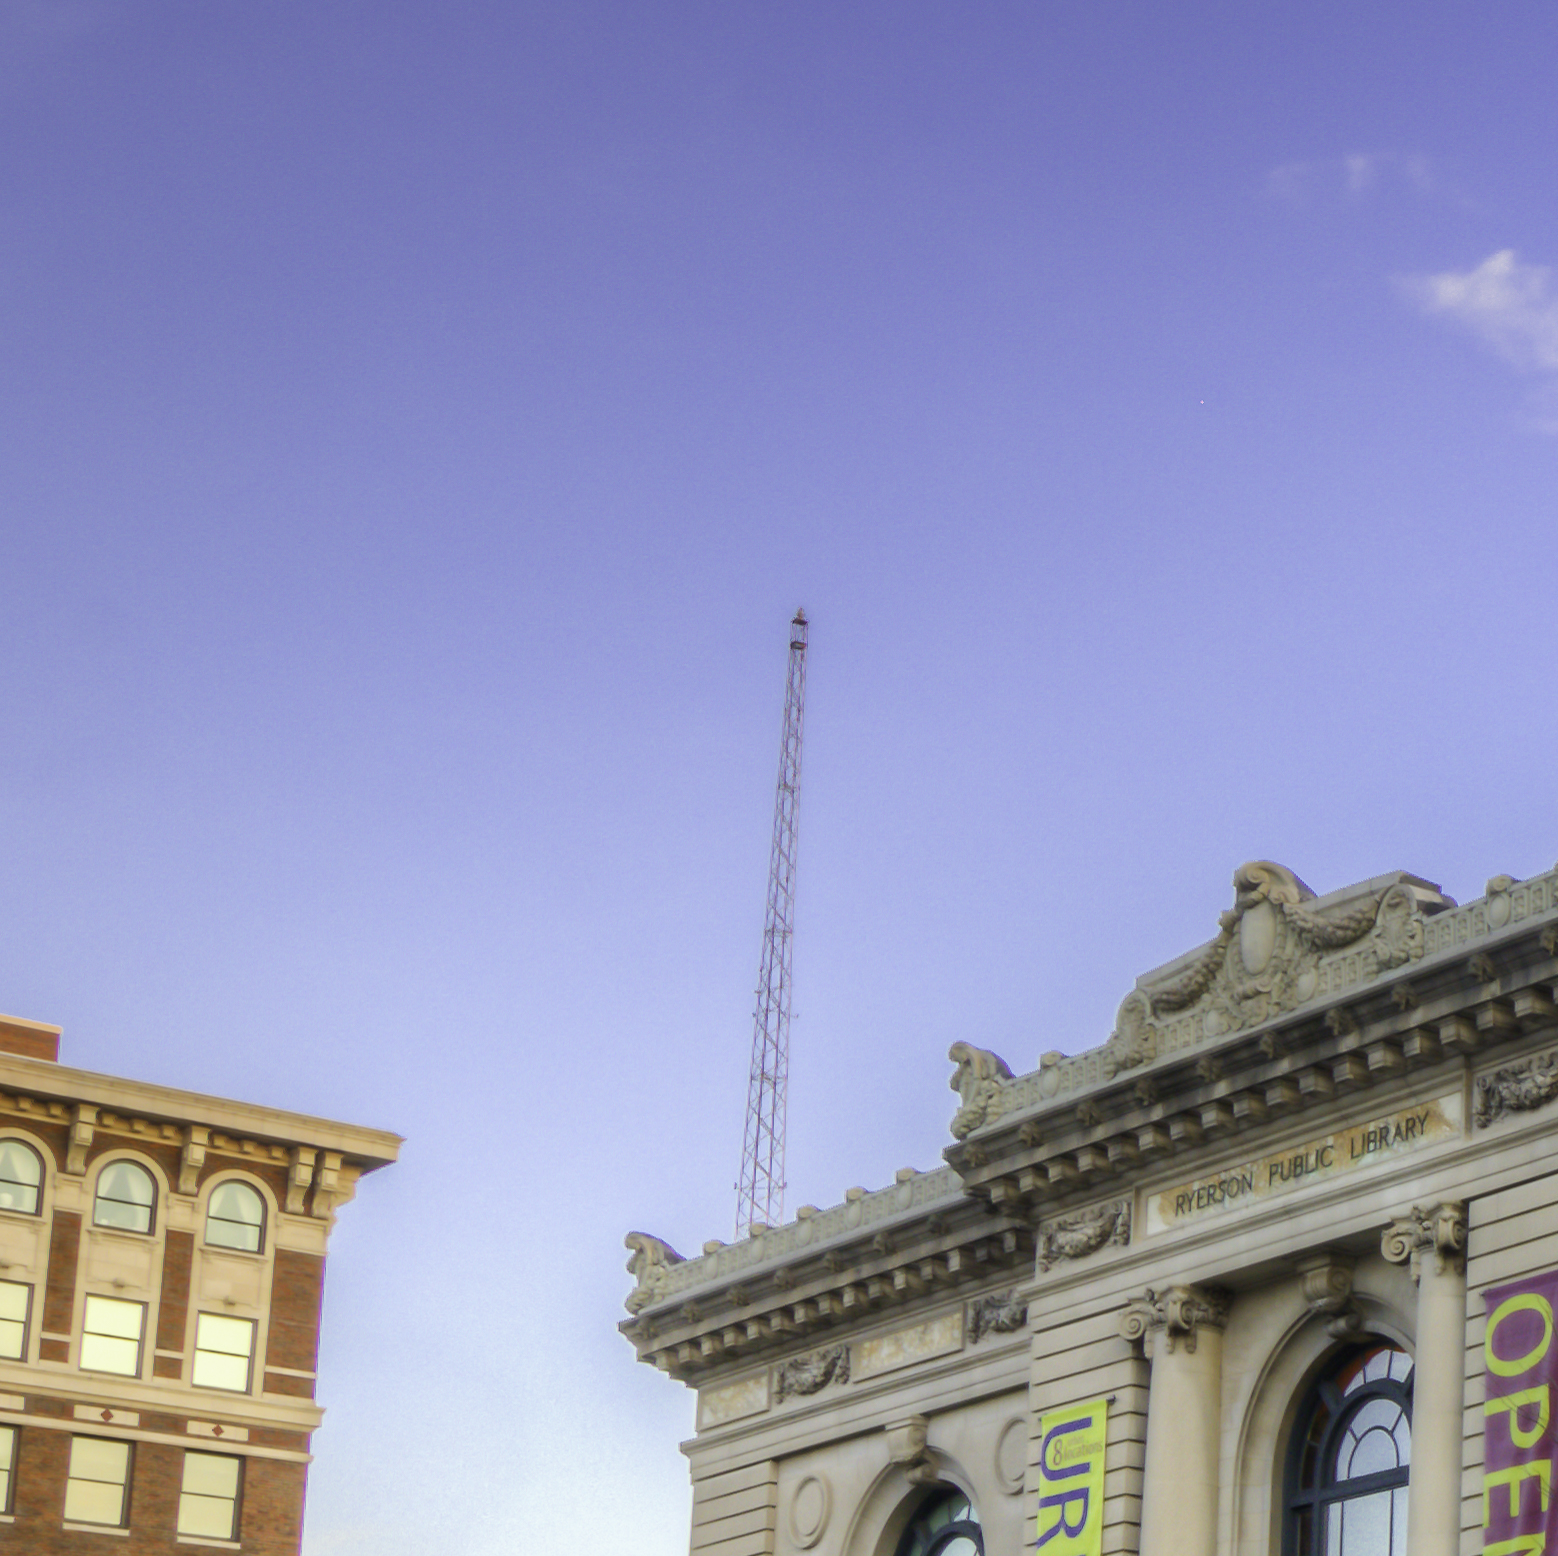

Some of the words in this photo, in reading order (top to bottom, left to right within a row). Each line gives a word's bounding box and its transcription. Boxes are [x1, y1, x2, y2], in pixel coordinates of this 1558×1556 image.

[1174, 1171, 1254, 1217] RYERSON
[1268, 1145, 1334, 1187] PUBLIC
[1350, 1110, 1430, 1160] LIBRARY
[1052, 1438, 1063, 1467] 8
[1063, 1441, 1103, 1462] locations
